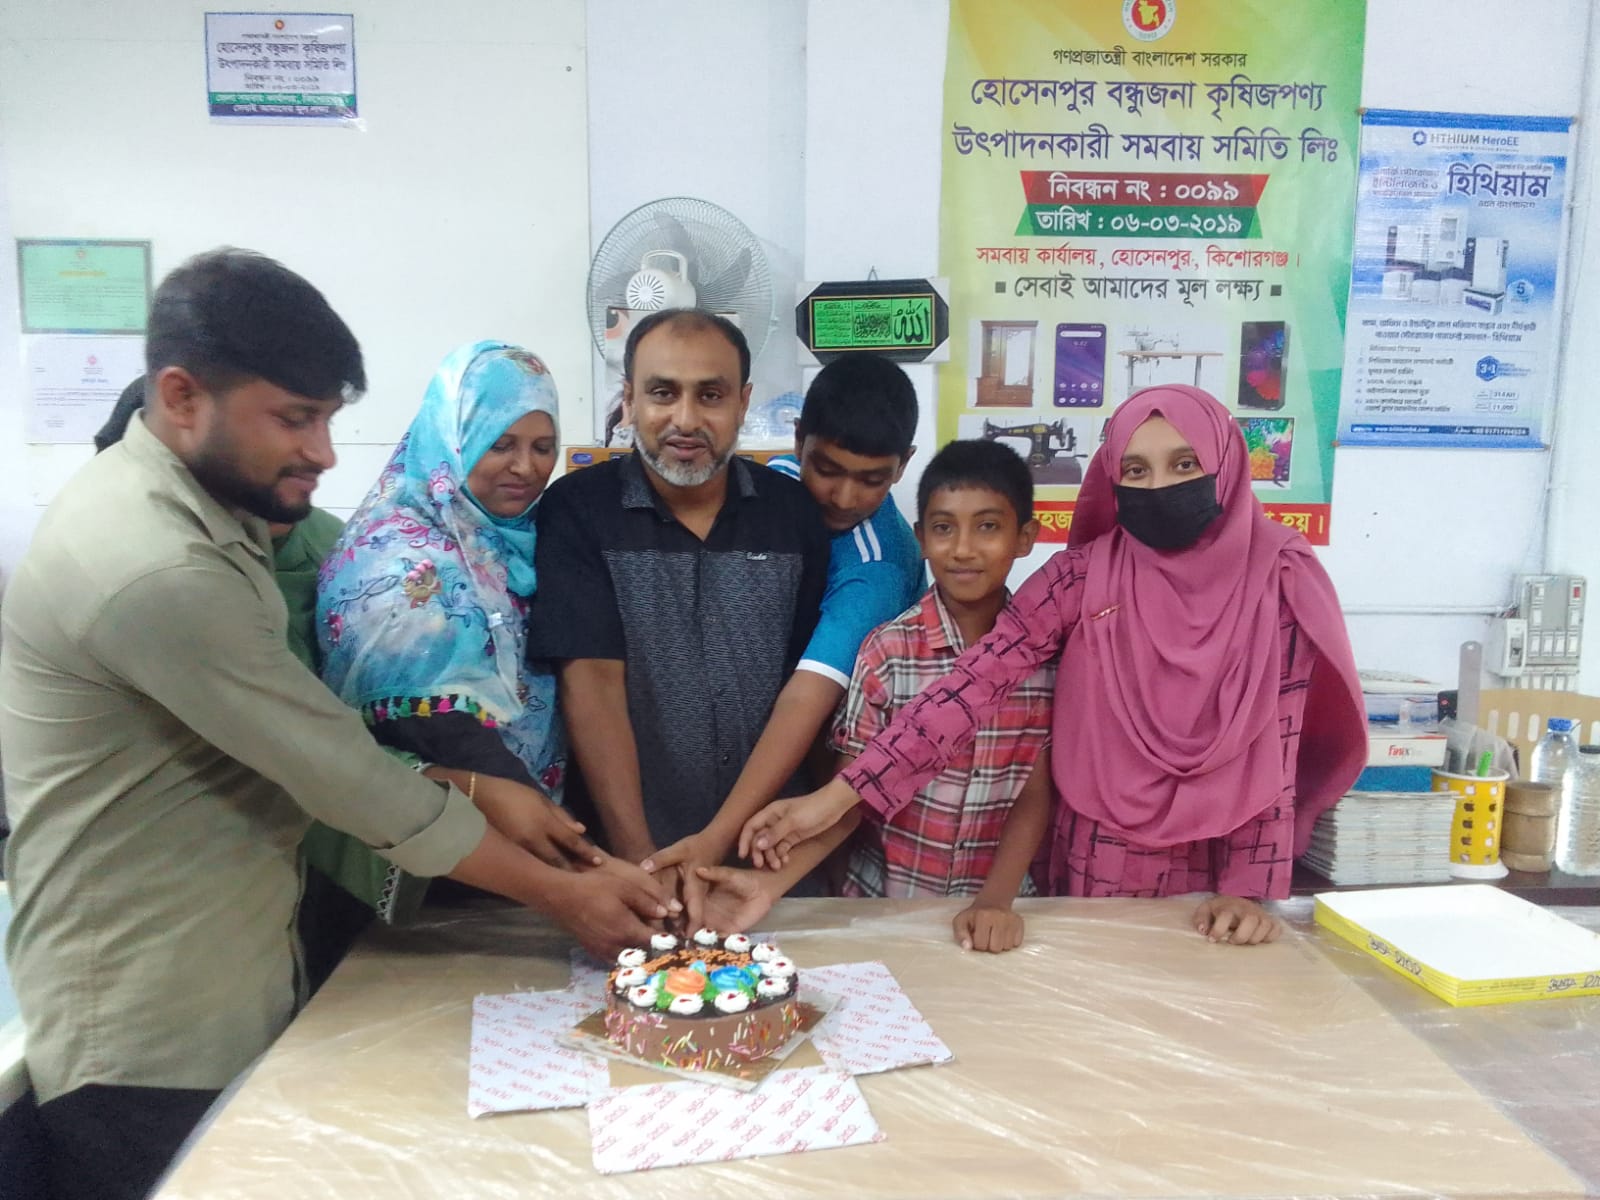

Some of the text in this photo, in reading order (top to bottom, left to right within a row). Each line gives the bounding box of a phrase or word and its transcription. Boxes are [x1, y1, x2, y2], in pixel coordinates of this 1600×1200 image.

[1053, 44, 1248, 67] গণপ্রজাতন্ত্রী বাংলাদেশ সরকার
[971, 74, 1327, 122] হোসেনপুর বন্ধুজনা কৃষিজপণ্য
[952, 121, 1338, 162] উৎপাদনকারী সমবায় সমিতি লিঃ
[1047, 172, 1120, 200] নিবন্ধন
[1124, 178, 1151, 202] নং
[1175, 181, 1239, 200] ০০৯৯
[1447, 162, 1551, 198] হিথিয়াম
[1035, 205, 1092, 232] তারিখ
[1111, 214, 1242, 235] ০৬-০৩-২০১৯
[976, 246, 1030, 264] সমবায়
[1014, 270, 1264, 307] সেবাই আমাদের মূল লক্ষ্য
